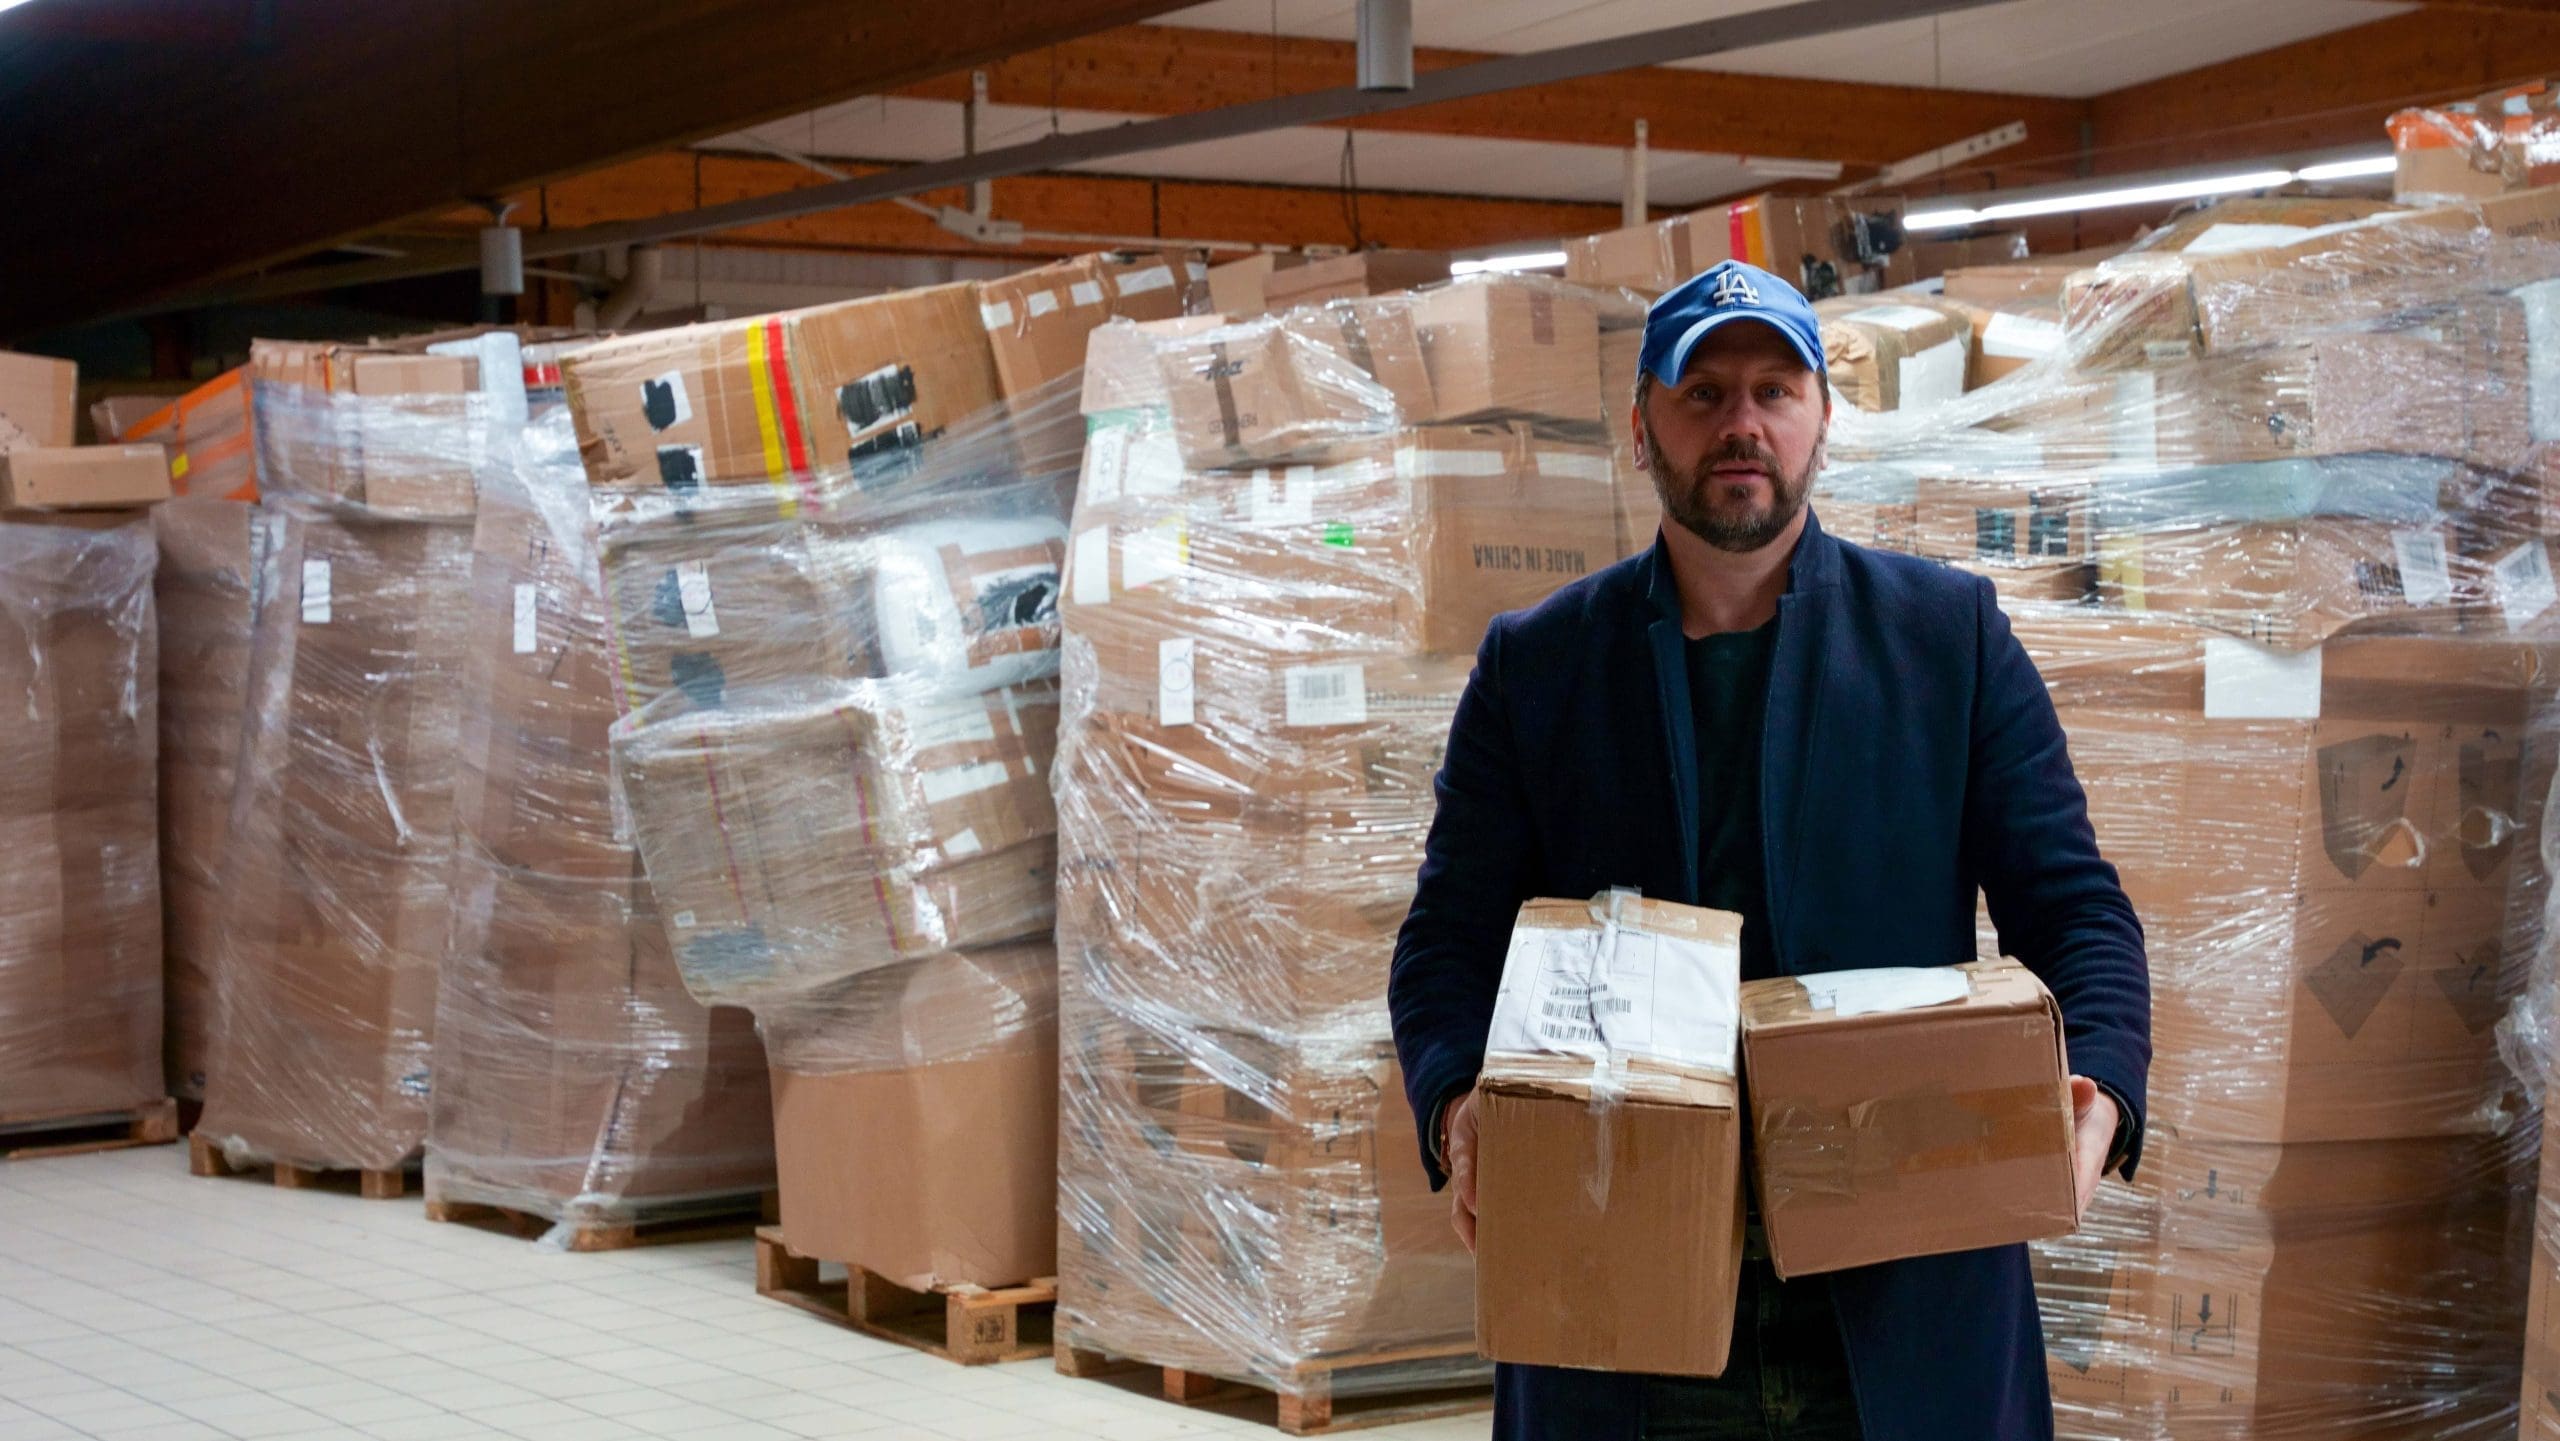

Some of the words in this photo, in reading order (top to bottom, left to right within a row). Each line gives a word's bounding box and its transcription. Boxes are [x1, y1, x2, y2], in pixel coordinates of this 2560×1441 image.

[1713, 269, 1760, 306] LA
[1472, 543, 1521, 571] CHINA
[1525, 546, 1541, 572] IN
[1545, 548, 1585, 574] MADE
